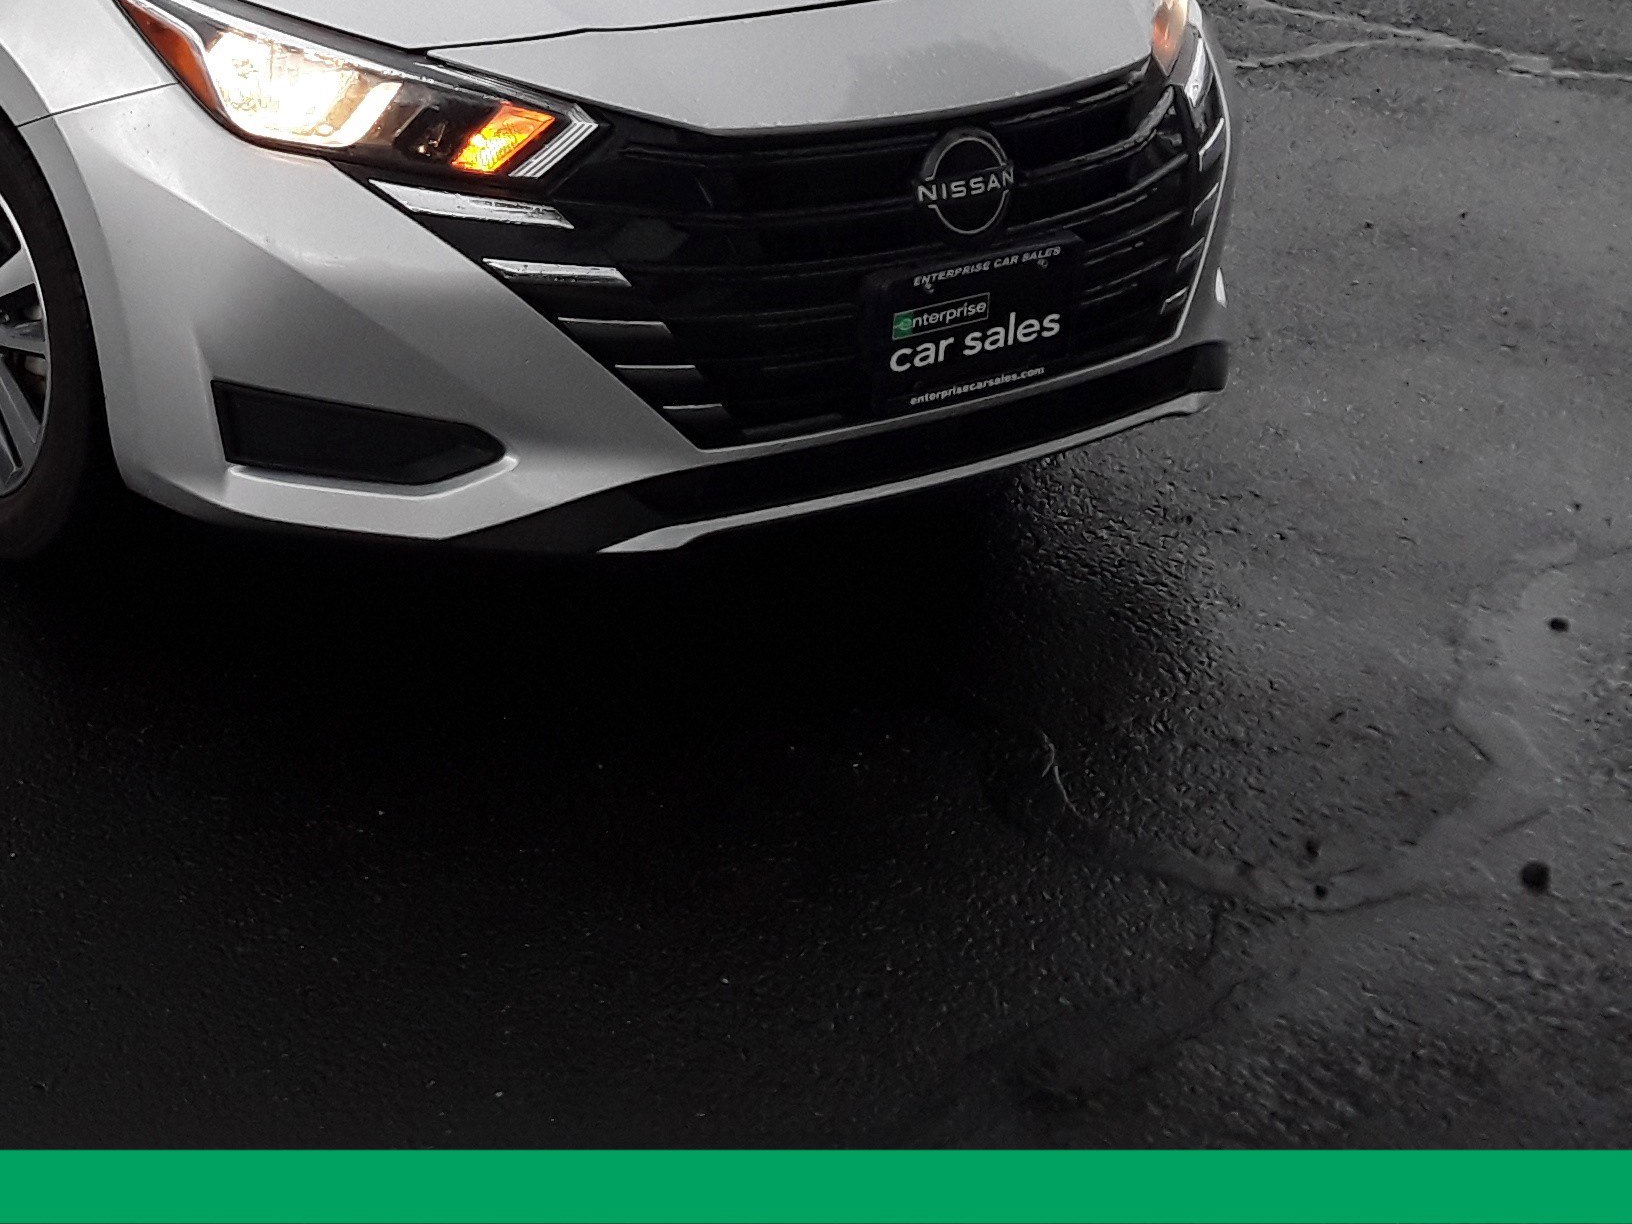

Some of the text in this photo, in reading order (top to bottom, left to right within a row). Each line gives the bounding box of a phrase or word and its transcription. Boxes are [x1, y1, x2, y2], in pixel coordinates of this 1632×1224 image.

[918, 166, 1014, 202] NISSAN
[913, 246, 1061, 287] ENTERPRISE CAR SALES
[898, 301, 987, 332] enterprise
[889, 311, 1061, 373] car sales
[909, 366, 1045, 406] enterprisecarsales.com
